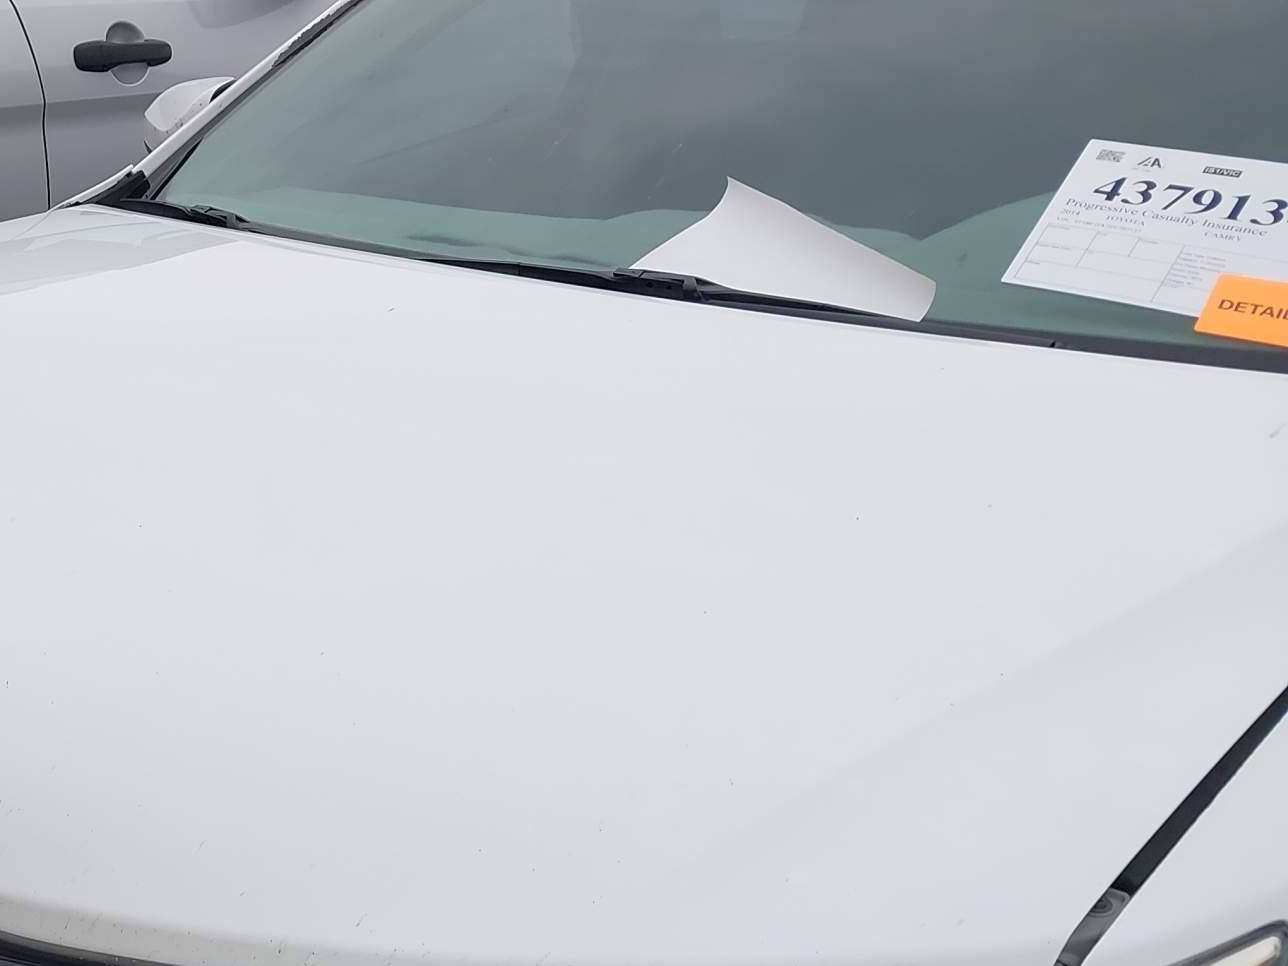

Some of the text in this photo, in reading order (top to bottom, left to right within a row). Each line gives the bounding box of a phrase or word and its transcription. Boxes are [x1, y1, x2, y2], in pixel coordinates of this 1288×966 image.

[1066, 199, 1139, 216] Progressive
[1142, 210, 1195, 226] Casualty
[1202, 219, 1268, 237] Insurance
[1093, 177, 1288, 226] 437913
[1106, 215, 1145, 226] TOYOTA
[1204, 232, 1242, 242] CAMRY
